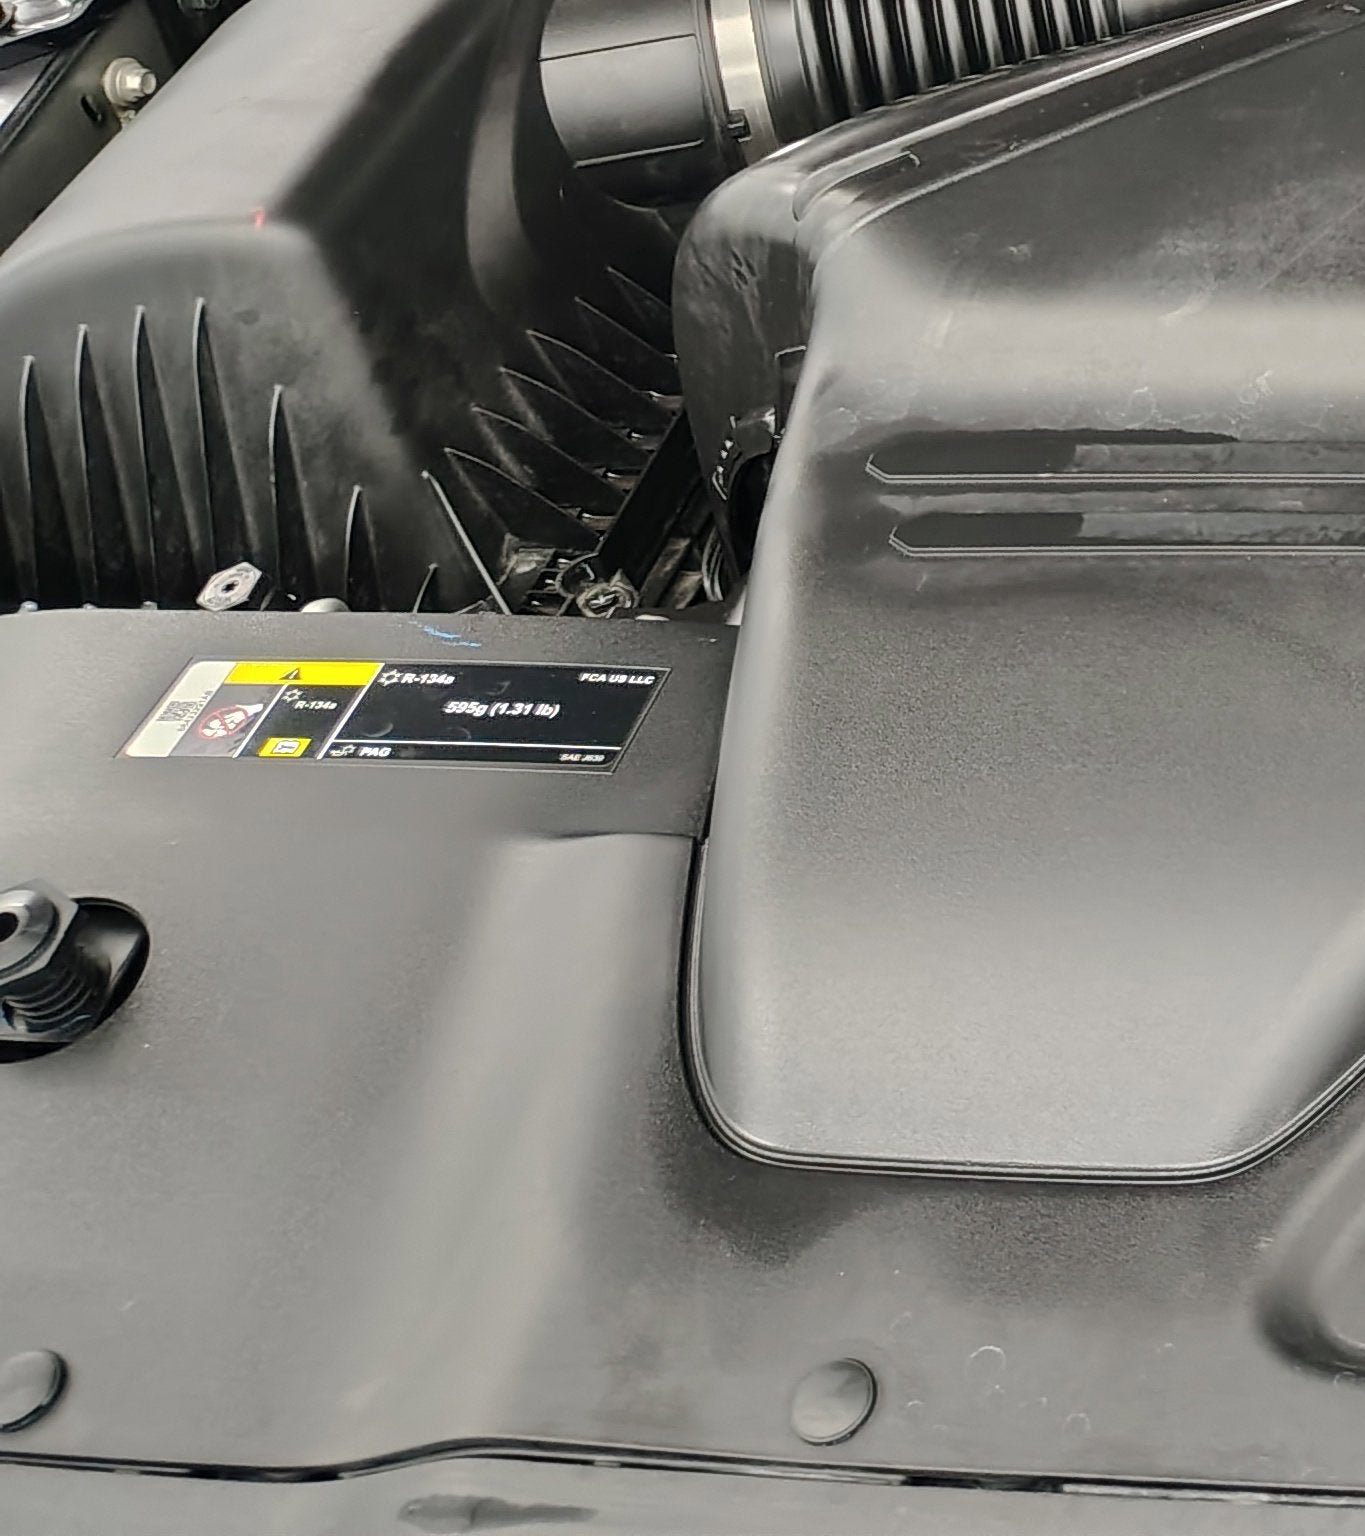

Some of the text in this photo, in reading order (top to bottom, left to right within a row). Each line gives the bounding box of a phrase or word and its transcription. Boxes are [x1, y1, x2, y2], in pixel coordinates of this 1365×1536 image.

[400, 672, 456, 685] R-134a
[579, 672, 656, 685] FCA US LLC
[293, 700, 338, 711] R-134a
[442, 700, 561, 719] 595g (1.31 lb)
[358, 746, 393, 758] PAG
